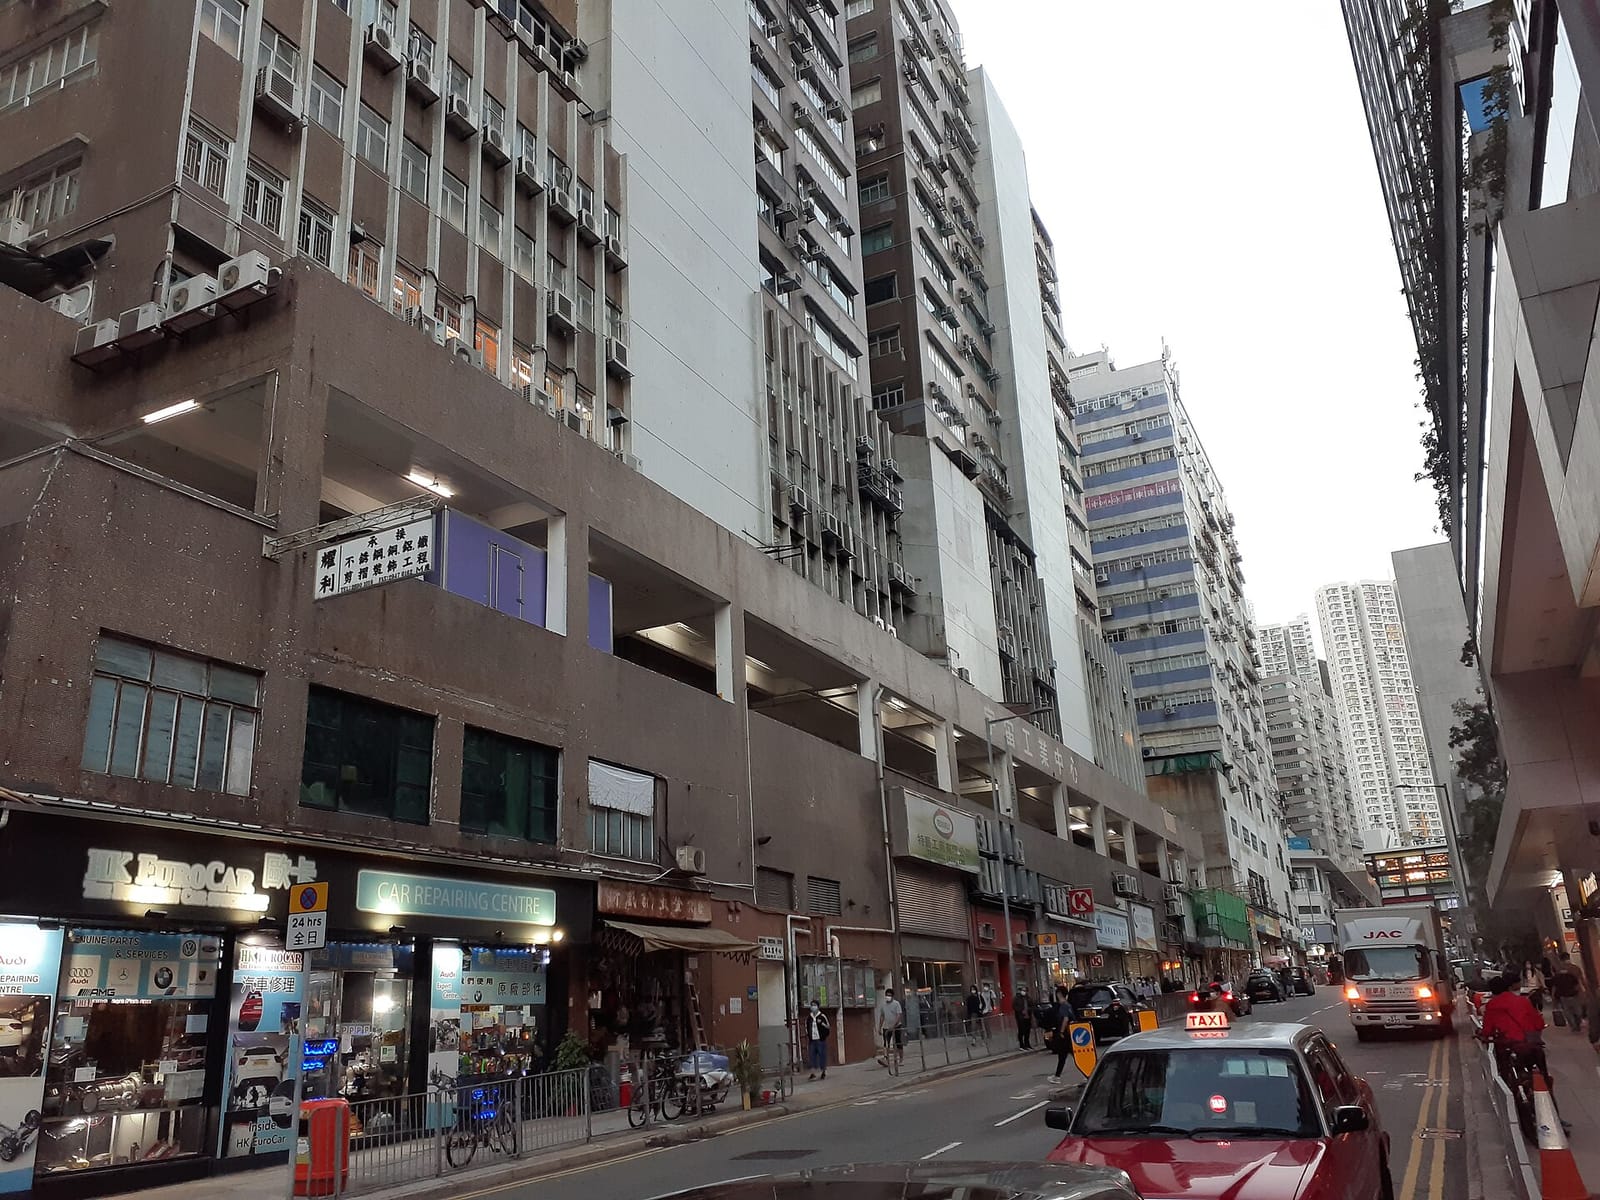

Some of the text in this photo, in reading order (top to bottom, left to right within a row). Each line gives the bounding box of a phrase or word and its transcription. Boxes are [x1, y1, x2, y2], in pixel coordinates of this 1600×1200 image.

[367, 527, 406, 548] 承接
[86, 848, 133, 884] HK
[377, 881, 541, 914] CAR REPAIRING CENTRE
[292, 917, 322, 928] 24 hrs
[109, 936, 139, 946] PARTS
[293, 931, 317, 946] 全日
[1363, 930, 1403, 939] JAC
[126, 950, 168, 959] SERVICES
[241, 976, 295, 993] 汽車修理
[1189, 1015, 1224, 1026] TAXI
[248, 1120, 277, 1132] Inside
[236, 1134, 286, 1148] HK EuroCar
